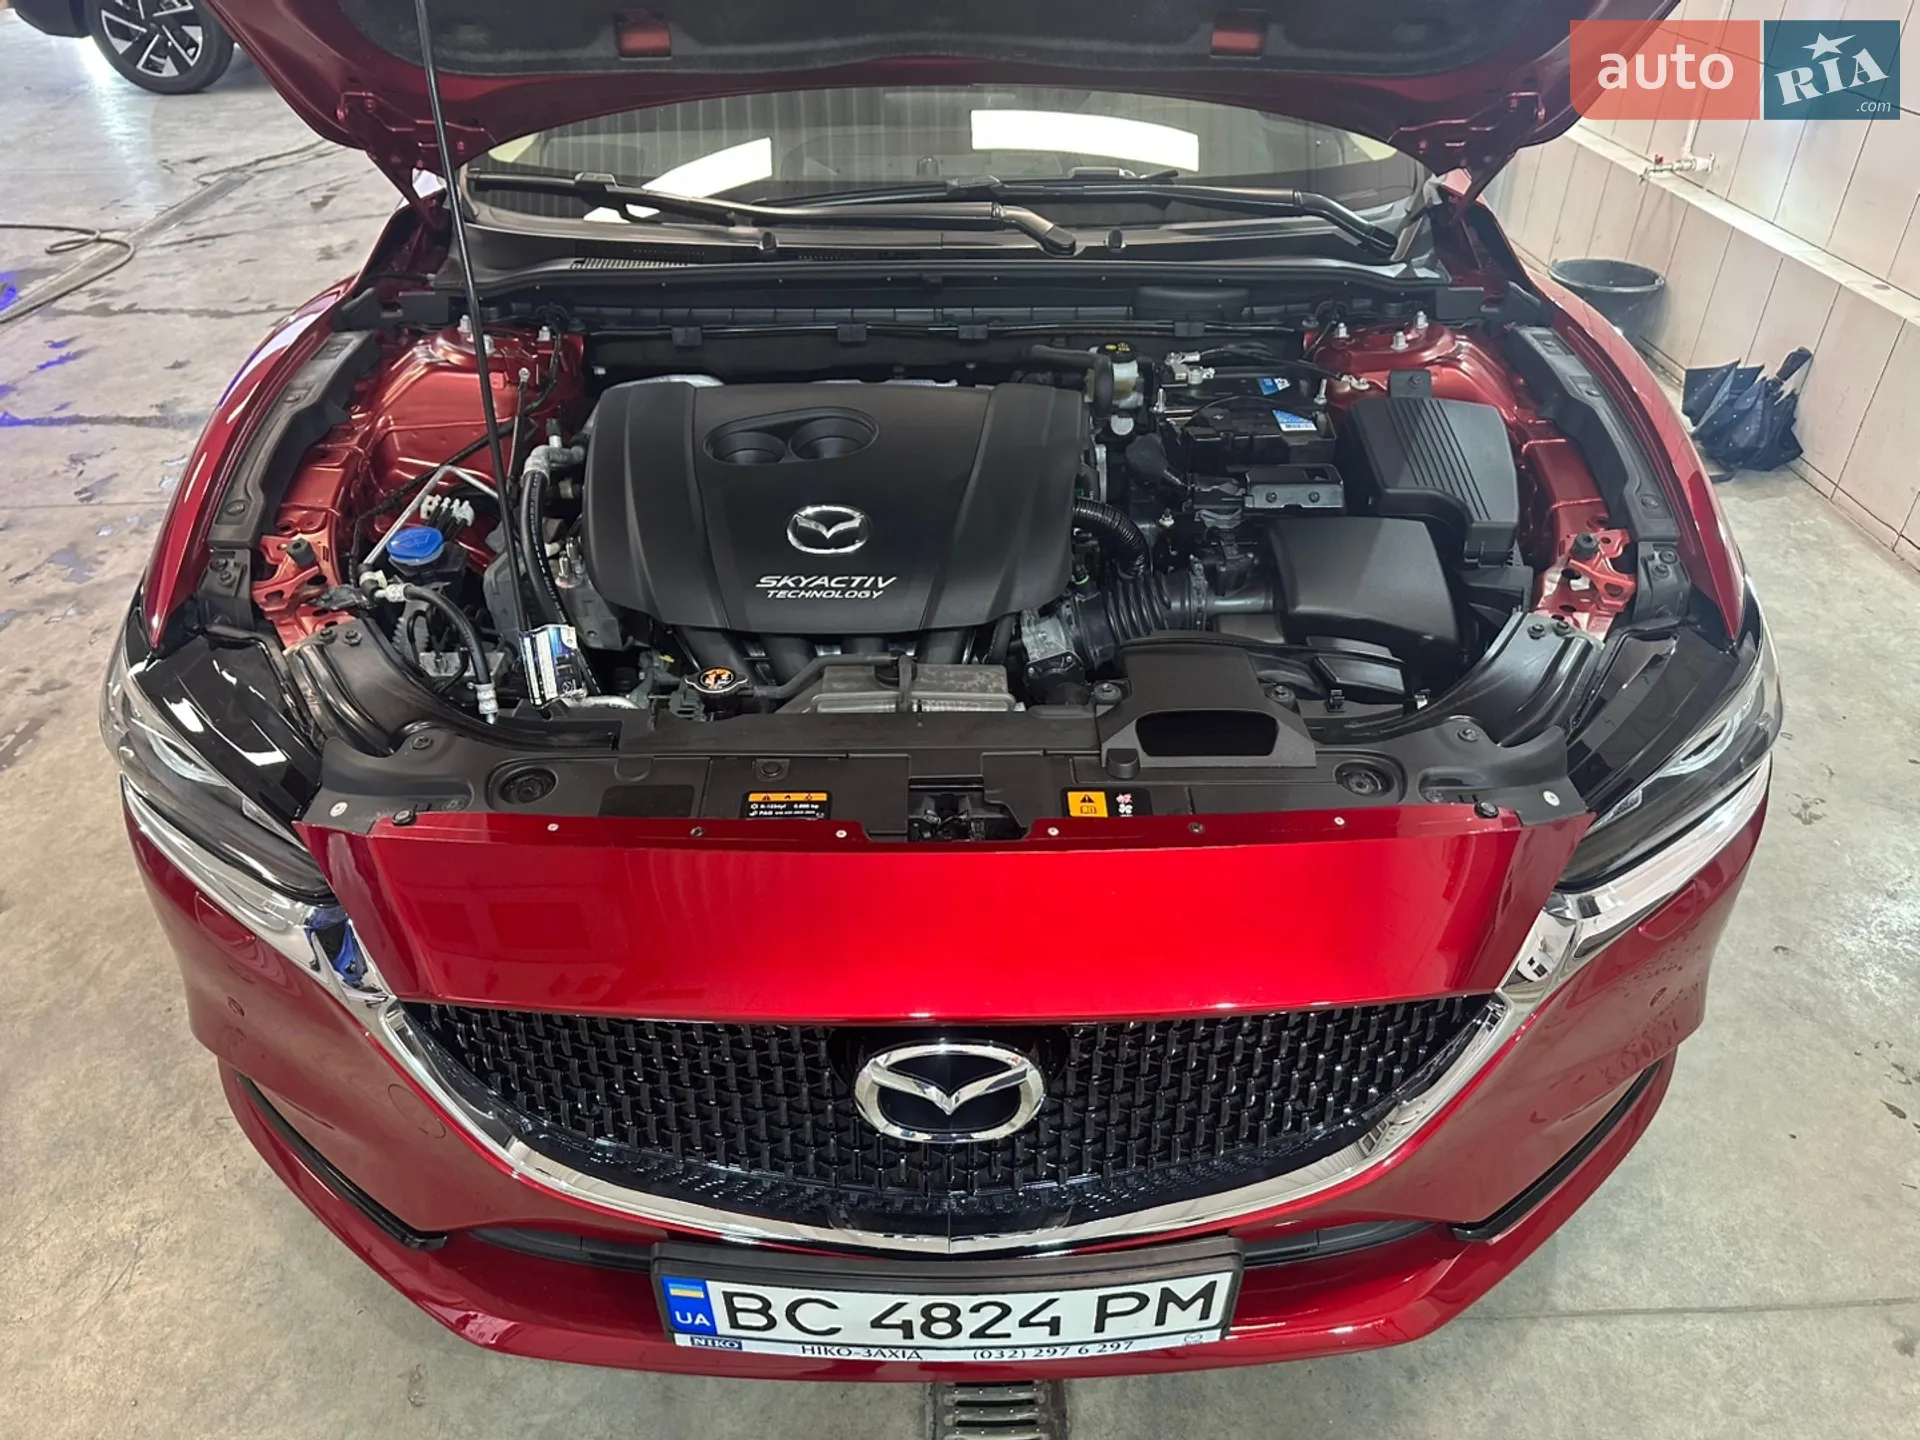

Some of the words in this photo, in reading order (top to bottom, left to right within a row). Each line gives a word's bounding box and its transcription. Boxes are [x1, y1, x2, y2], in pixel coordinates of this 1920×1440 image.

[755, 575, 898, 589] SKYACTIV
[767, 589, 884, 599] TECHNOLOGY
[722, 1290, 843, 1337] BC
[869, 1297, 1062, 1341] 4824
[1093, 1280, 1218, 1334] PM
[675, 1311, 711, 1327] UA
[692, 1337, 740, 1349] NIKO
[973, 1349, 1026, 1361] (032)
[1033, 1346, 1070, 1358] 297
[1078, 1344, 1089, 1355] 6
[1097, 1340, 1134, 1354] 297
[800, 1344, 924, 1361] НІКО-ЗАХІД
